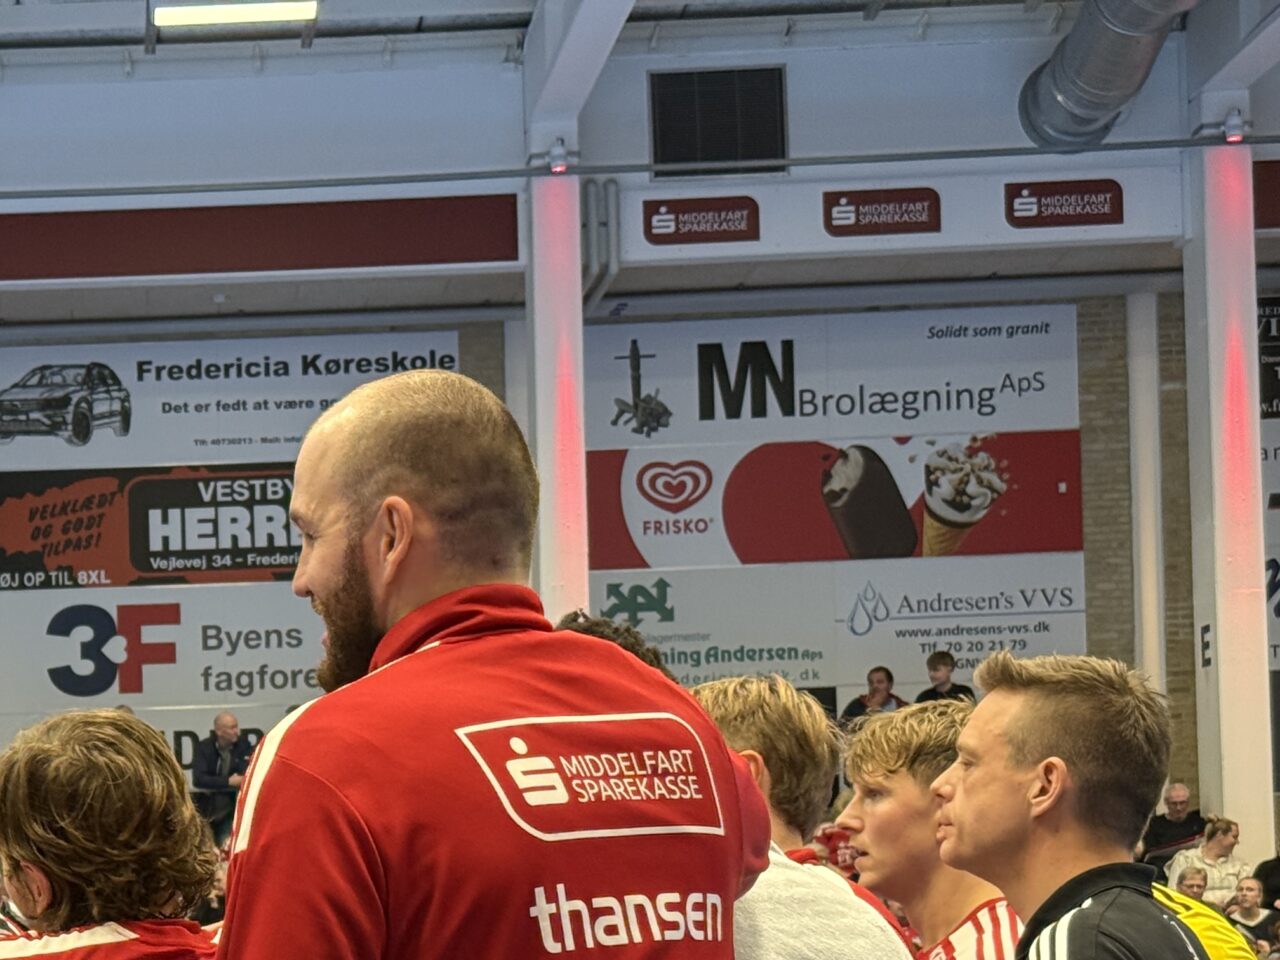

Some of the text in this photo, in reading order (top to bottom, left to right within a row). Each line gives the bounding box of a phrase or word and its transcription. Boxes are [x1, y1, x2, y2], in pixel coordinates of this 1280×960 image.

[858, 201, 929, 214] MIDDELFART
[1041, 193, 1112, 206] MIDDELFART
[678, 210, 749, 223] MIDDELFART
[858, 212, 929, 224] SPAREKASSE
[1041, 204, 1111, 216] SPAREKASSE
[679, 221, 748, 233] SPAREKASSE
[927, 321, 1050, 340] Solidt som granit
[135, 350, 457, 382] Fredericia Køreskole
[697, 340, 1045, 421] MN Brolægning ApS
[162, 402, 189, 414] Det
[194, 403, 210, 413] er
[216, 400, 247, 412] fedt
[253, 401, 269, 411] at
[274, 400, 314, 410] være
[643, 518, 709, 536] FRISKO
[150, 556, 207, 570] Vejlevej
[211, 554, 232, 566] 34
[24, 571, 45, 587] OP
[49, 571, 73, 586] TIL
[77, 570, 111, 585] 8XL
[896, 586, 1075, 615] Andresen's VVS
[895, 622, 1050, 639] www.andresens-vvs.dk
[201, 625, 303, 656] Byens
[946, 642, 963, 653] 70
[967, 641, 984, 652] 20
[1010, 639, 1027, 651] 79
[46, 603, 181, 697] 3F
[704, 645, 799, 665] Andersen
[559, 749, 694, 778] MIDDELFART
[571, 775, 703, 804] SPAREKASSE
[529, 883, 722, 954] thansen
